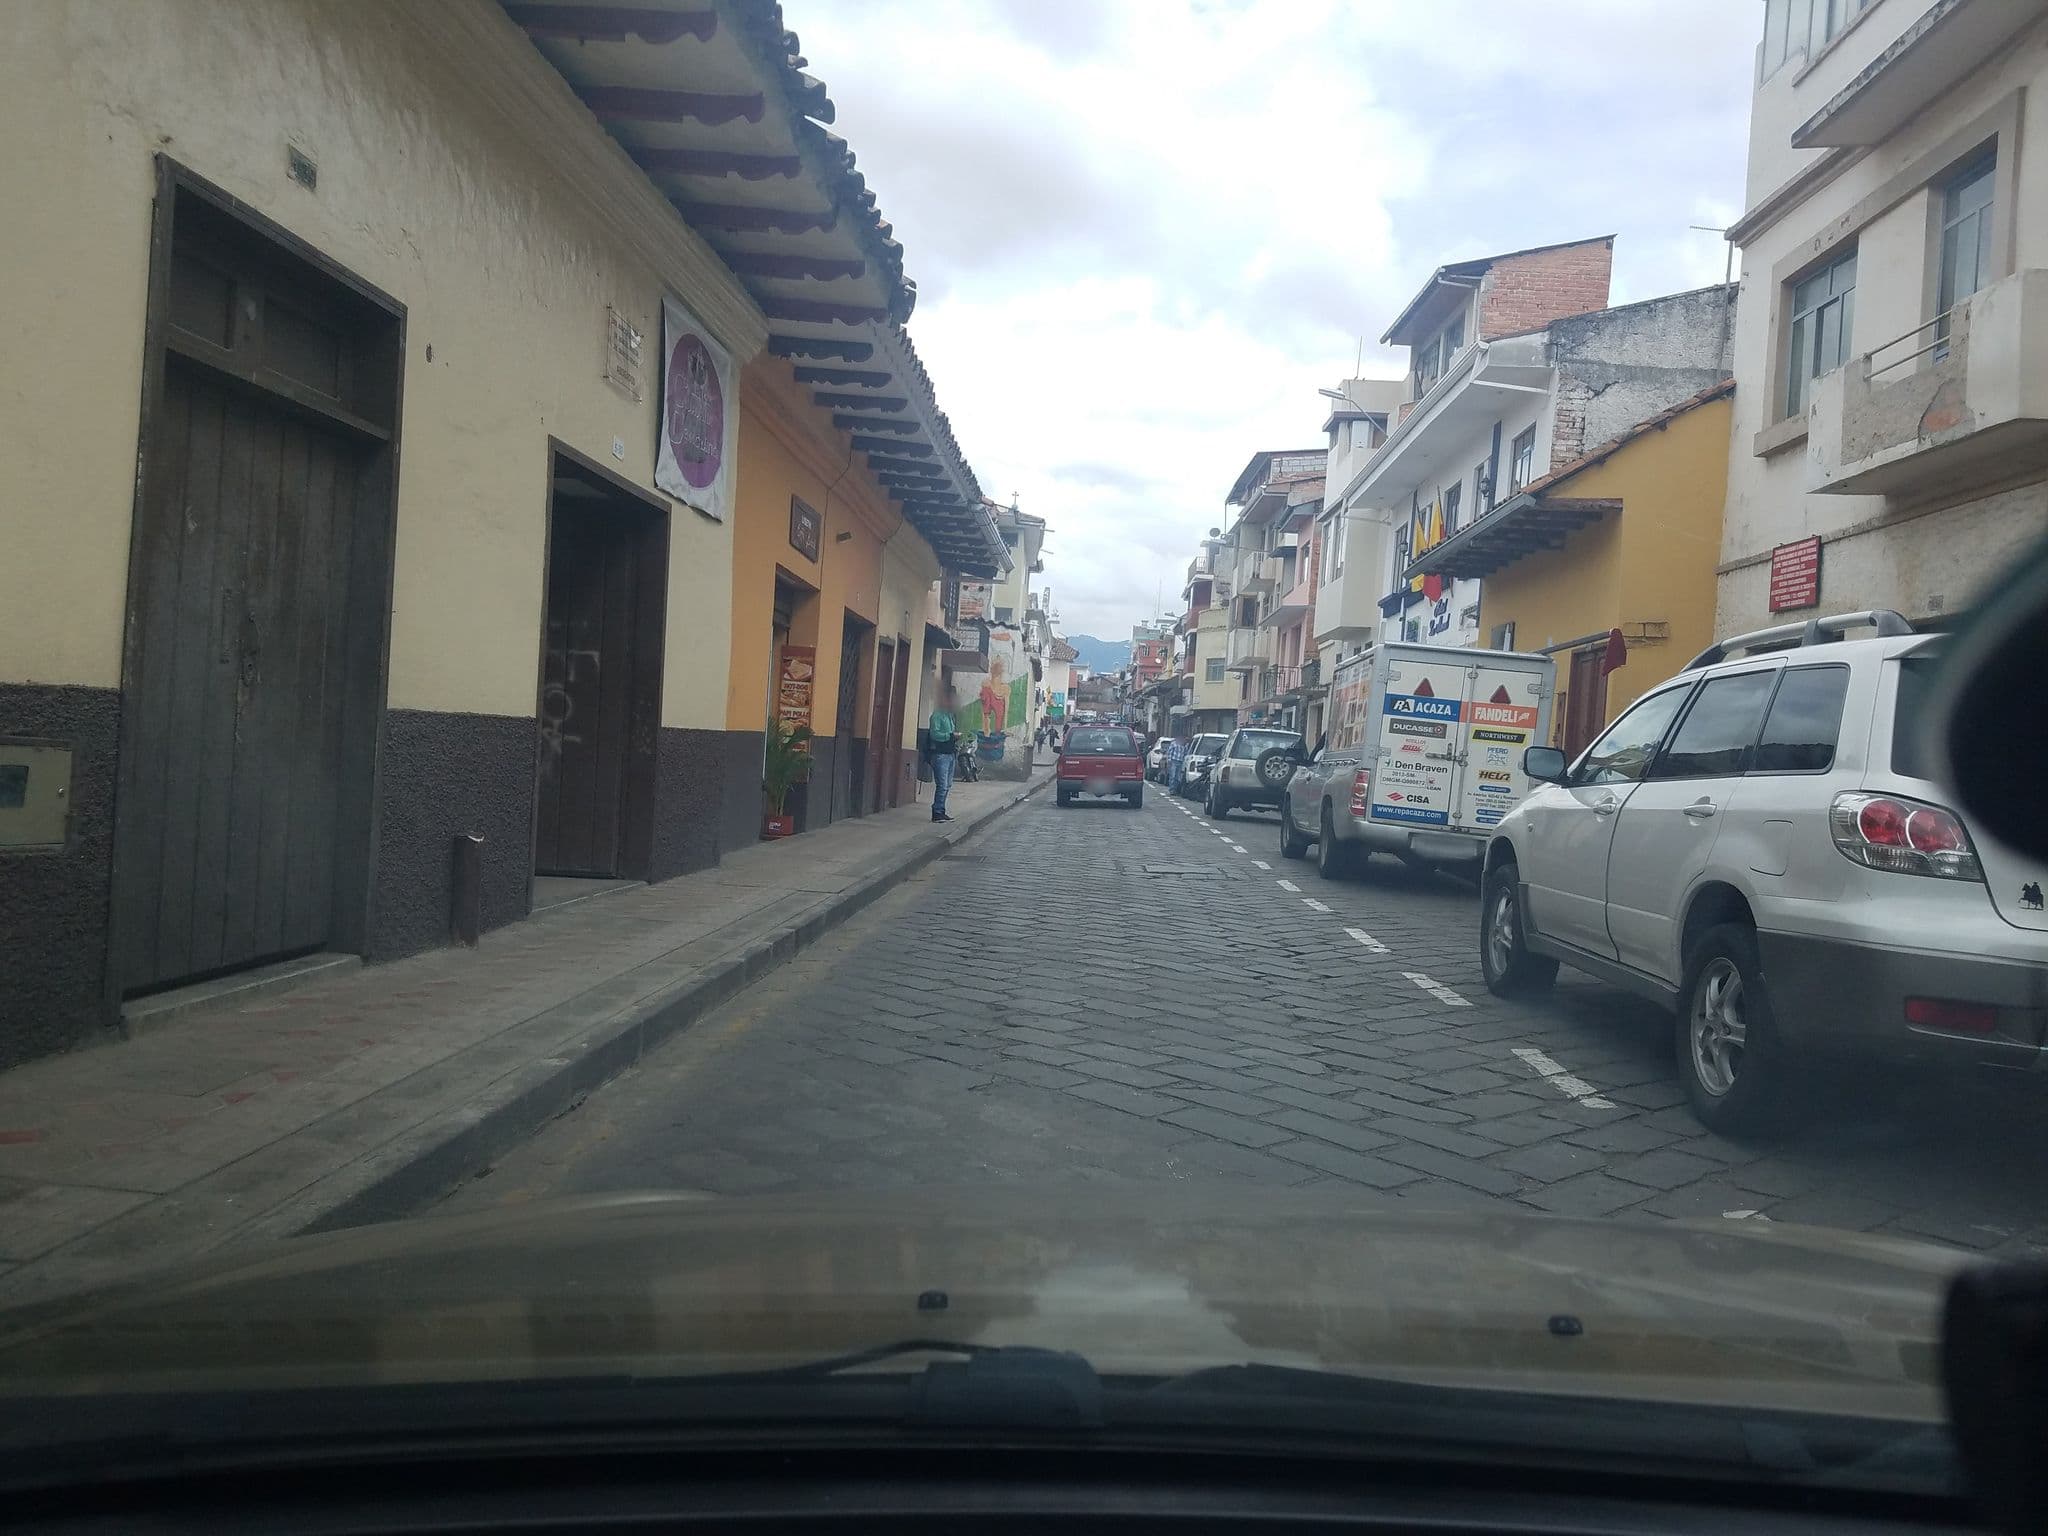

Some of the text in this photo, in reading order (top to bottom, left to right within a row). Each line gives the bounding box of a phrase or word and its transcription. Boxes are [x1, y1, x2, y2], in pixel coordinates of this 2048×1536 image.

[1415, 702, 1451, 716] ACAZA
[1475, 707, 1518, 723] FANDELI
[1393, 723, 1434, 733] DUCASSE
[1480, 731, 1518, 741] NORTHWEST
[1395, 760, 1449, 774] Den Braven
[1406, 794, 1430, 804] CISA
[1376, 805, 1442, 819] www.repacaza.com
